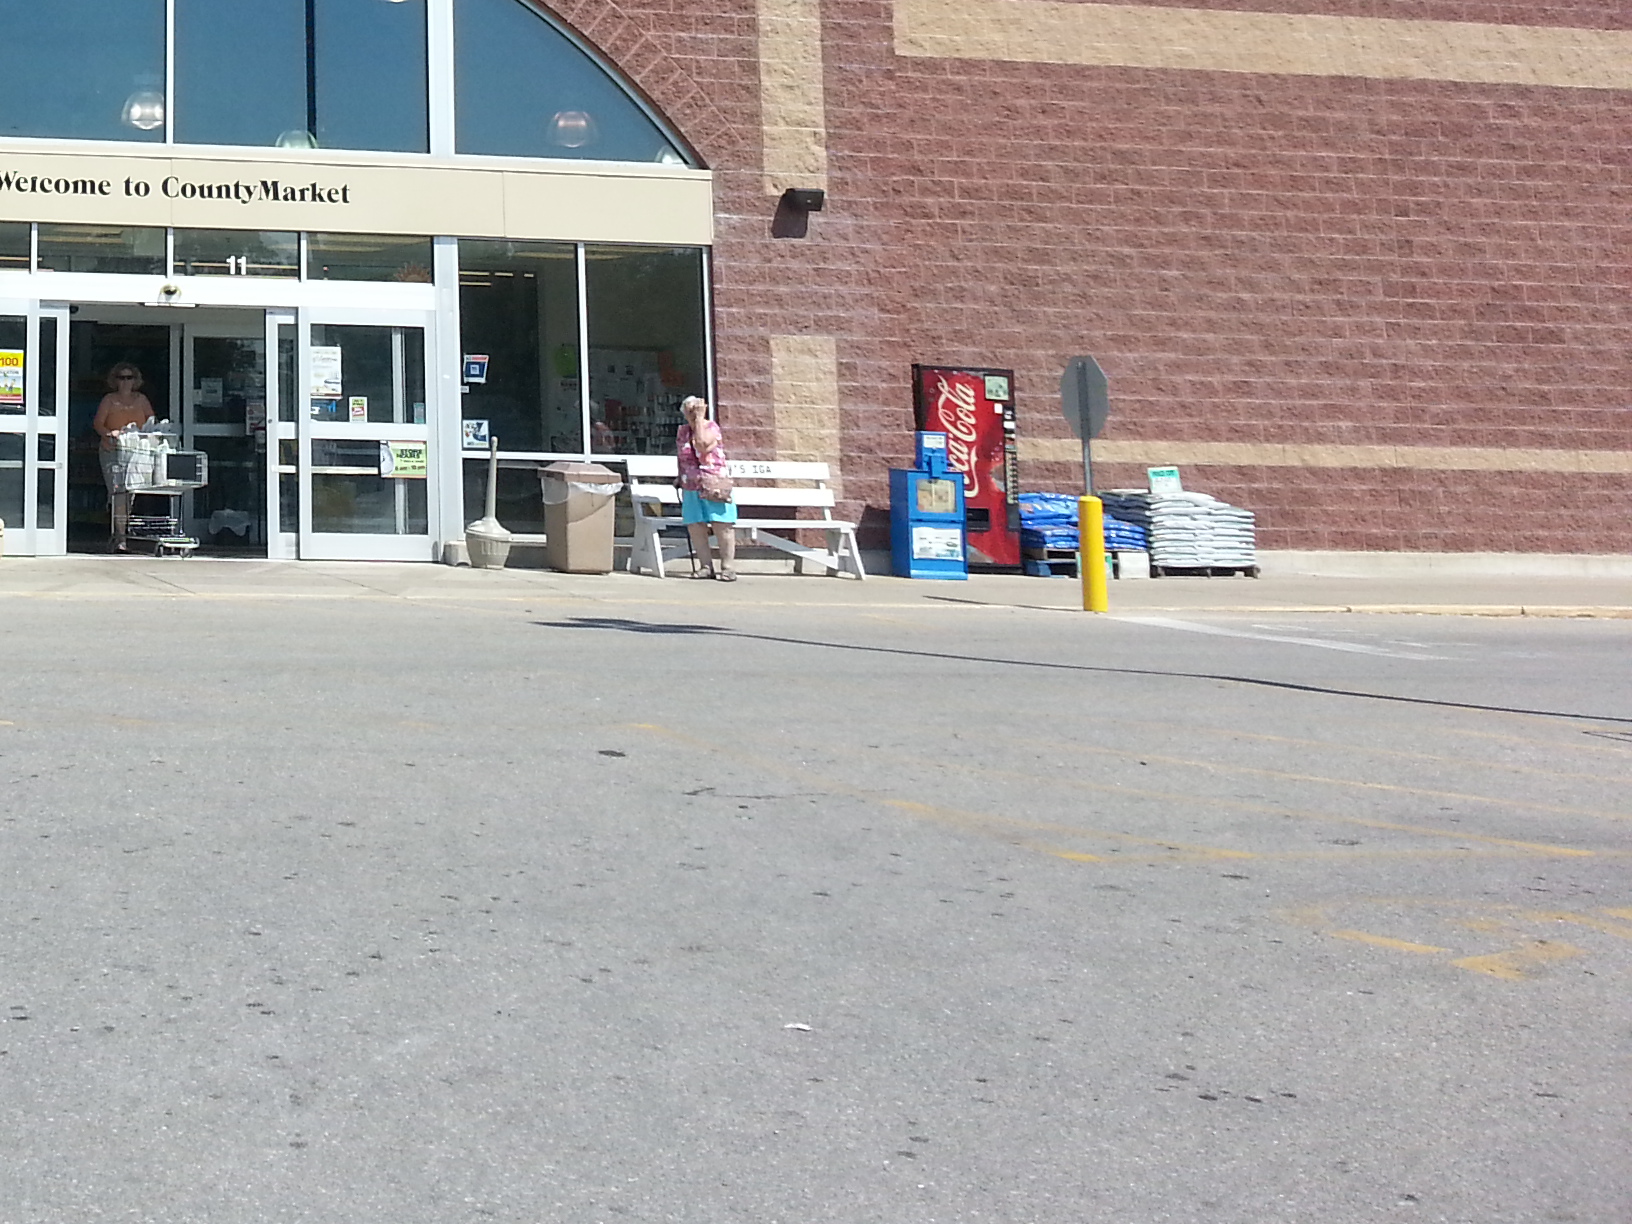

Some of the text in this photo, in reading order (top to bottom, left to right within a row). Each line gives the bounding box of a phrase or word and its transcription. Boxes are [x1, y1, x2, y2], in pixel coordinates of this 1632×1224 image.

[124, 176, 151, 198] to
[161, 176, 351, 205] CountyMarket
[226, 255, 247, 276] 11
[752, 464, 772, 475] IGA
